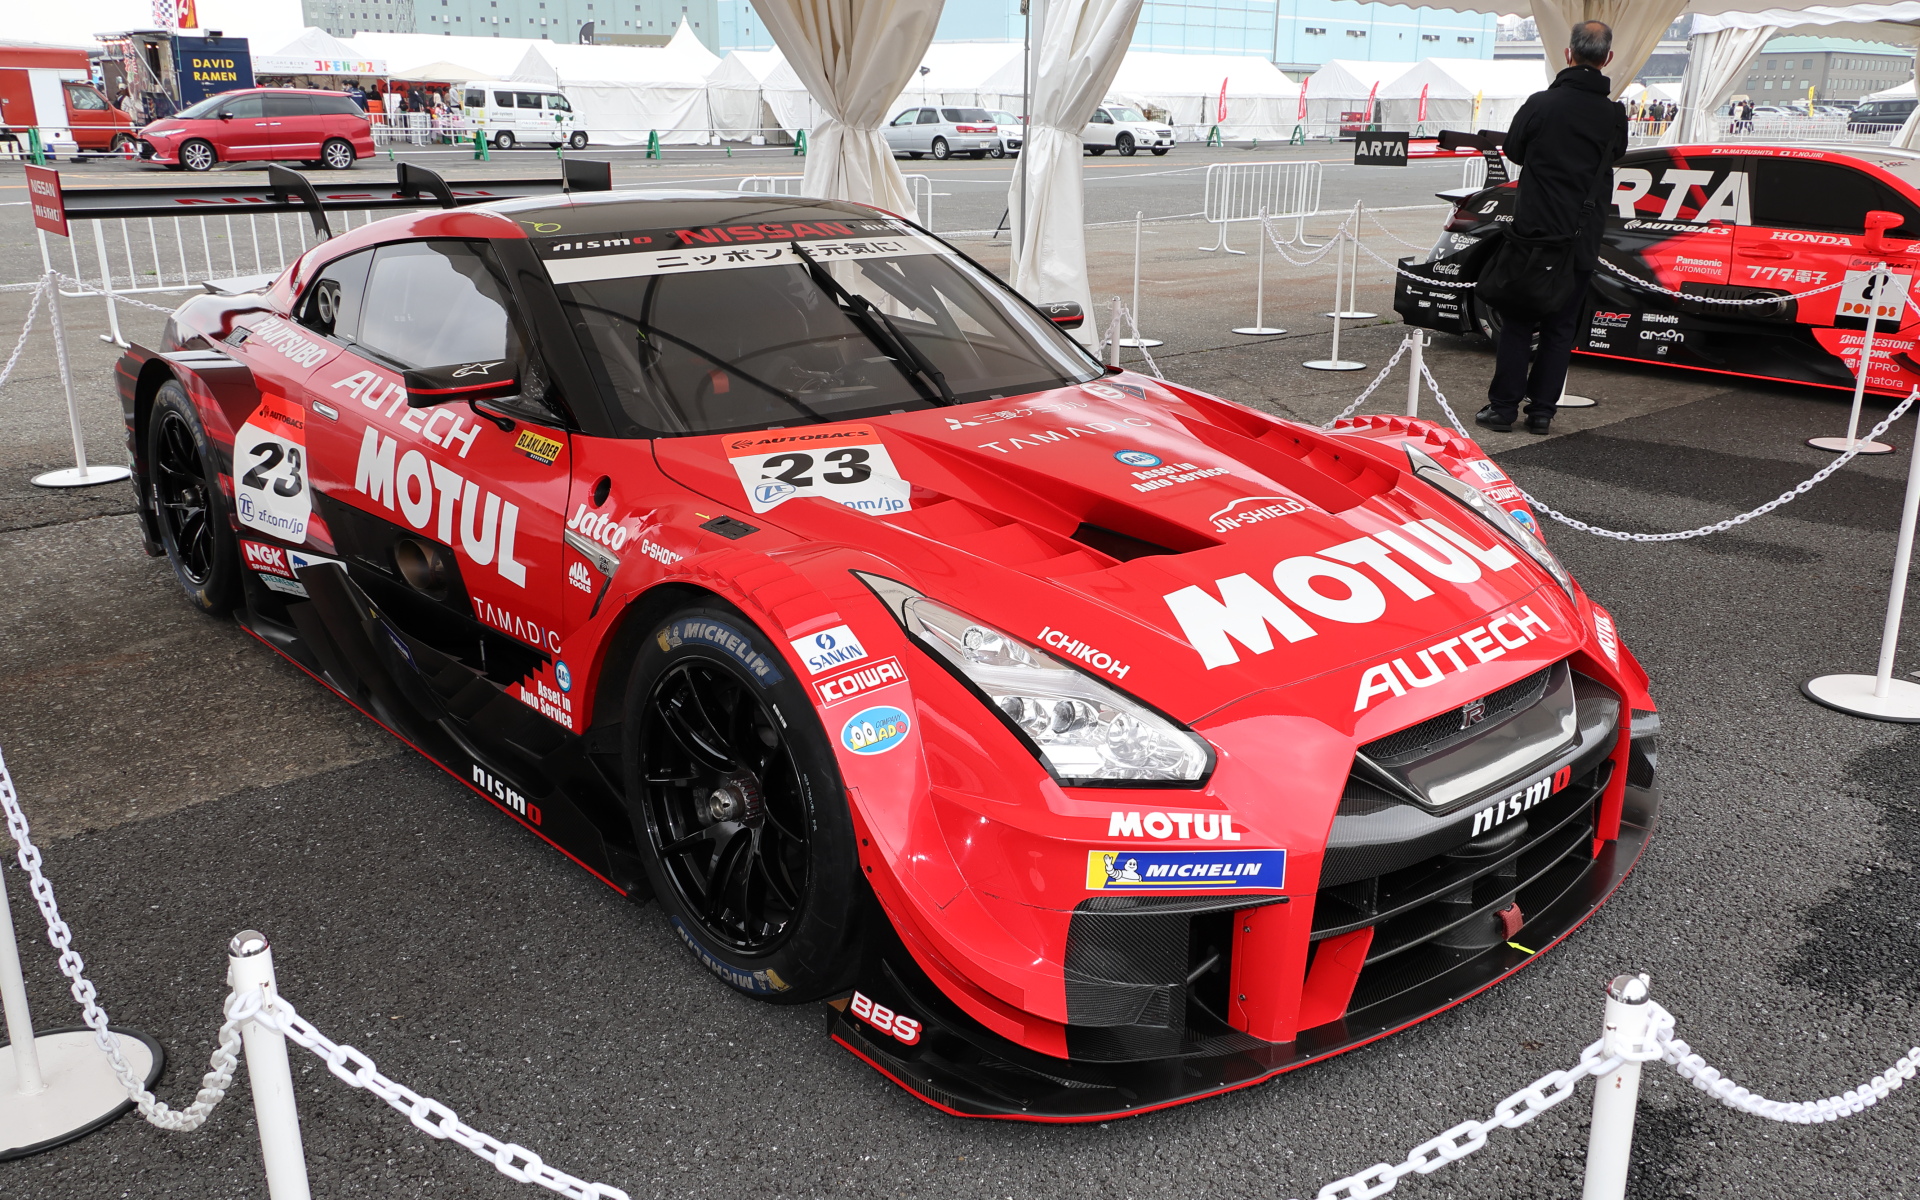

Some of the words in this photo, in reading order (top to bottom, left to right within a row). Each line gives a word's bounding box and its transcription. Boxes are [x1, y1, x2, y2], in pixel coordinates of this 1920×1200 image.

[193, 58, 234, 69] DAVID
[193, 72, 237, 81] RAMEN
[314, 60, 375, 72] コドモバックス
[1356, 141, 1406, 157] ARTA
[1722, 148, 1774, 156] N.MATSUSHITA
[30, 179, 56, 197] NISSAN
[553, 236, 652, 252] nismo
[674, 222, 855, 245] NISSAN
[1638, 221, 1731, 236] AUTOBACS
[1770, 231, 1852, 246] HONDA
[1672, 265, 1722, 276] AUTOMOTIVE
[1676, 256, 1722, 268] Panasonic
[1746, 265, 1828, 285] フクダ電子
[1592, 311, 1631, 325] HRC
[1656, 314, 1678, 324] Holts
[251, 317, 327, 369] FUJITSUBO
[1589, 340, 1610, 348] Calm
[1640, 329, 1684, 342] amon
[269, 410, 304, 430] AUTOBACS
[331, 369, 482, 459] AUTECH
[756, 430, 869, 446] AUTOBACS
[978, 418, 1152, 453] TAMADIC
[242, 442, 303, 498] 23
[761, 448, 872, 488] 23
[1130, 478, 1174, 492] Auto
[1166, 467, 1230, 484] Service
[1131, 465, 1182, 480] Asset
[1172, 462, 1198, 471] in
[354, 425, 526, 589] MOTUL
[1212, 501, 1306, 533] JN-SHIELD
[258, 509, 304, 535] zf.com/jp
[566, 503, 627, 551] Jatco
[244, 542, 286, 569] NGK
[641, 539, 684, 566] G-SHOCK
[252, 563, 273, 572] SPARK
[272, 568, 290, 577] PLUGS
[568, 562, 592, 586] MAC
[568, 577, 592, 594] TOOLS
[1162, 518, 1516, 671] MOTUL
[473, 596, 562, 654] TAMADIC
[683, 623, 770, 677] MICHELIN
[808, 643, 863, 672] SANKIN
[1037, 626, 1131, 680] ICHIKOH
[1353, 604, 1552, 713] AUTECH
[820, 661, 903, 702] KOIWAI
[520, 685, 540, 710] Auto
[540, 698, 573, 730] Service
[537, 679, 562, 706] Asset
[562, 694, 572, 713] in
[876, 714, 902, 729] COMPANY
[473, 764, 542, 826] nismo
[1471, 765, 1572, 838] nismo
[1108, 811, 1241, 842] MOTUL
[1145, 863, 1262, 878] MICHELIN
[850, 990, 921, 1043] BBS
